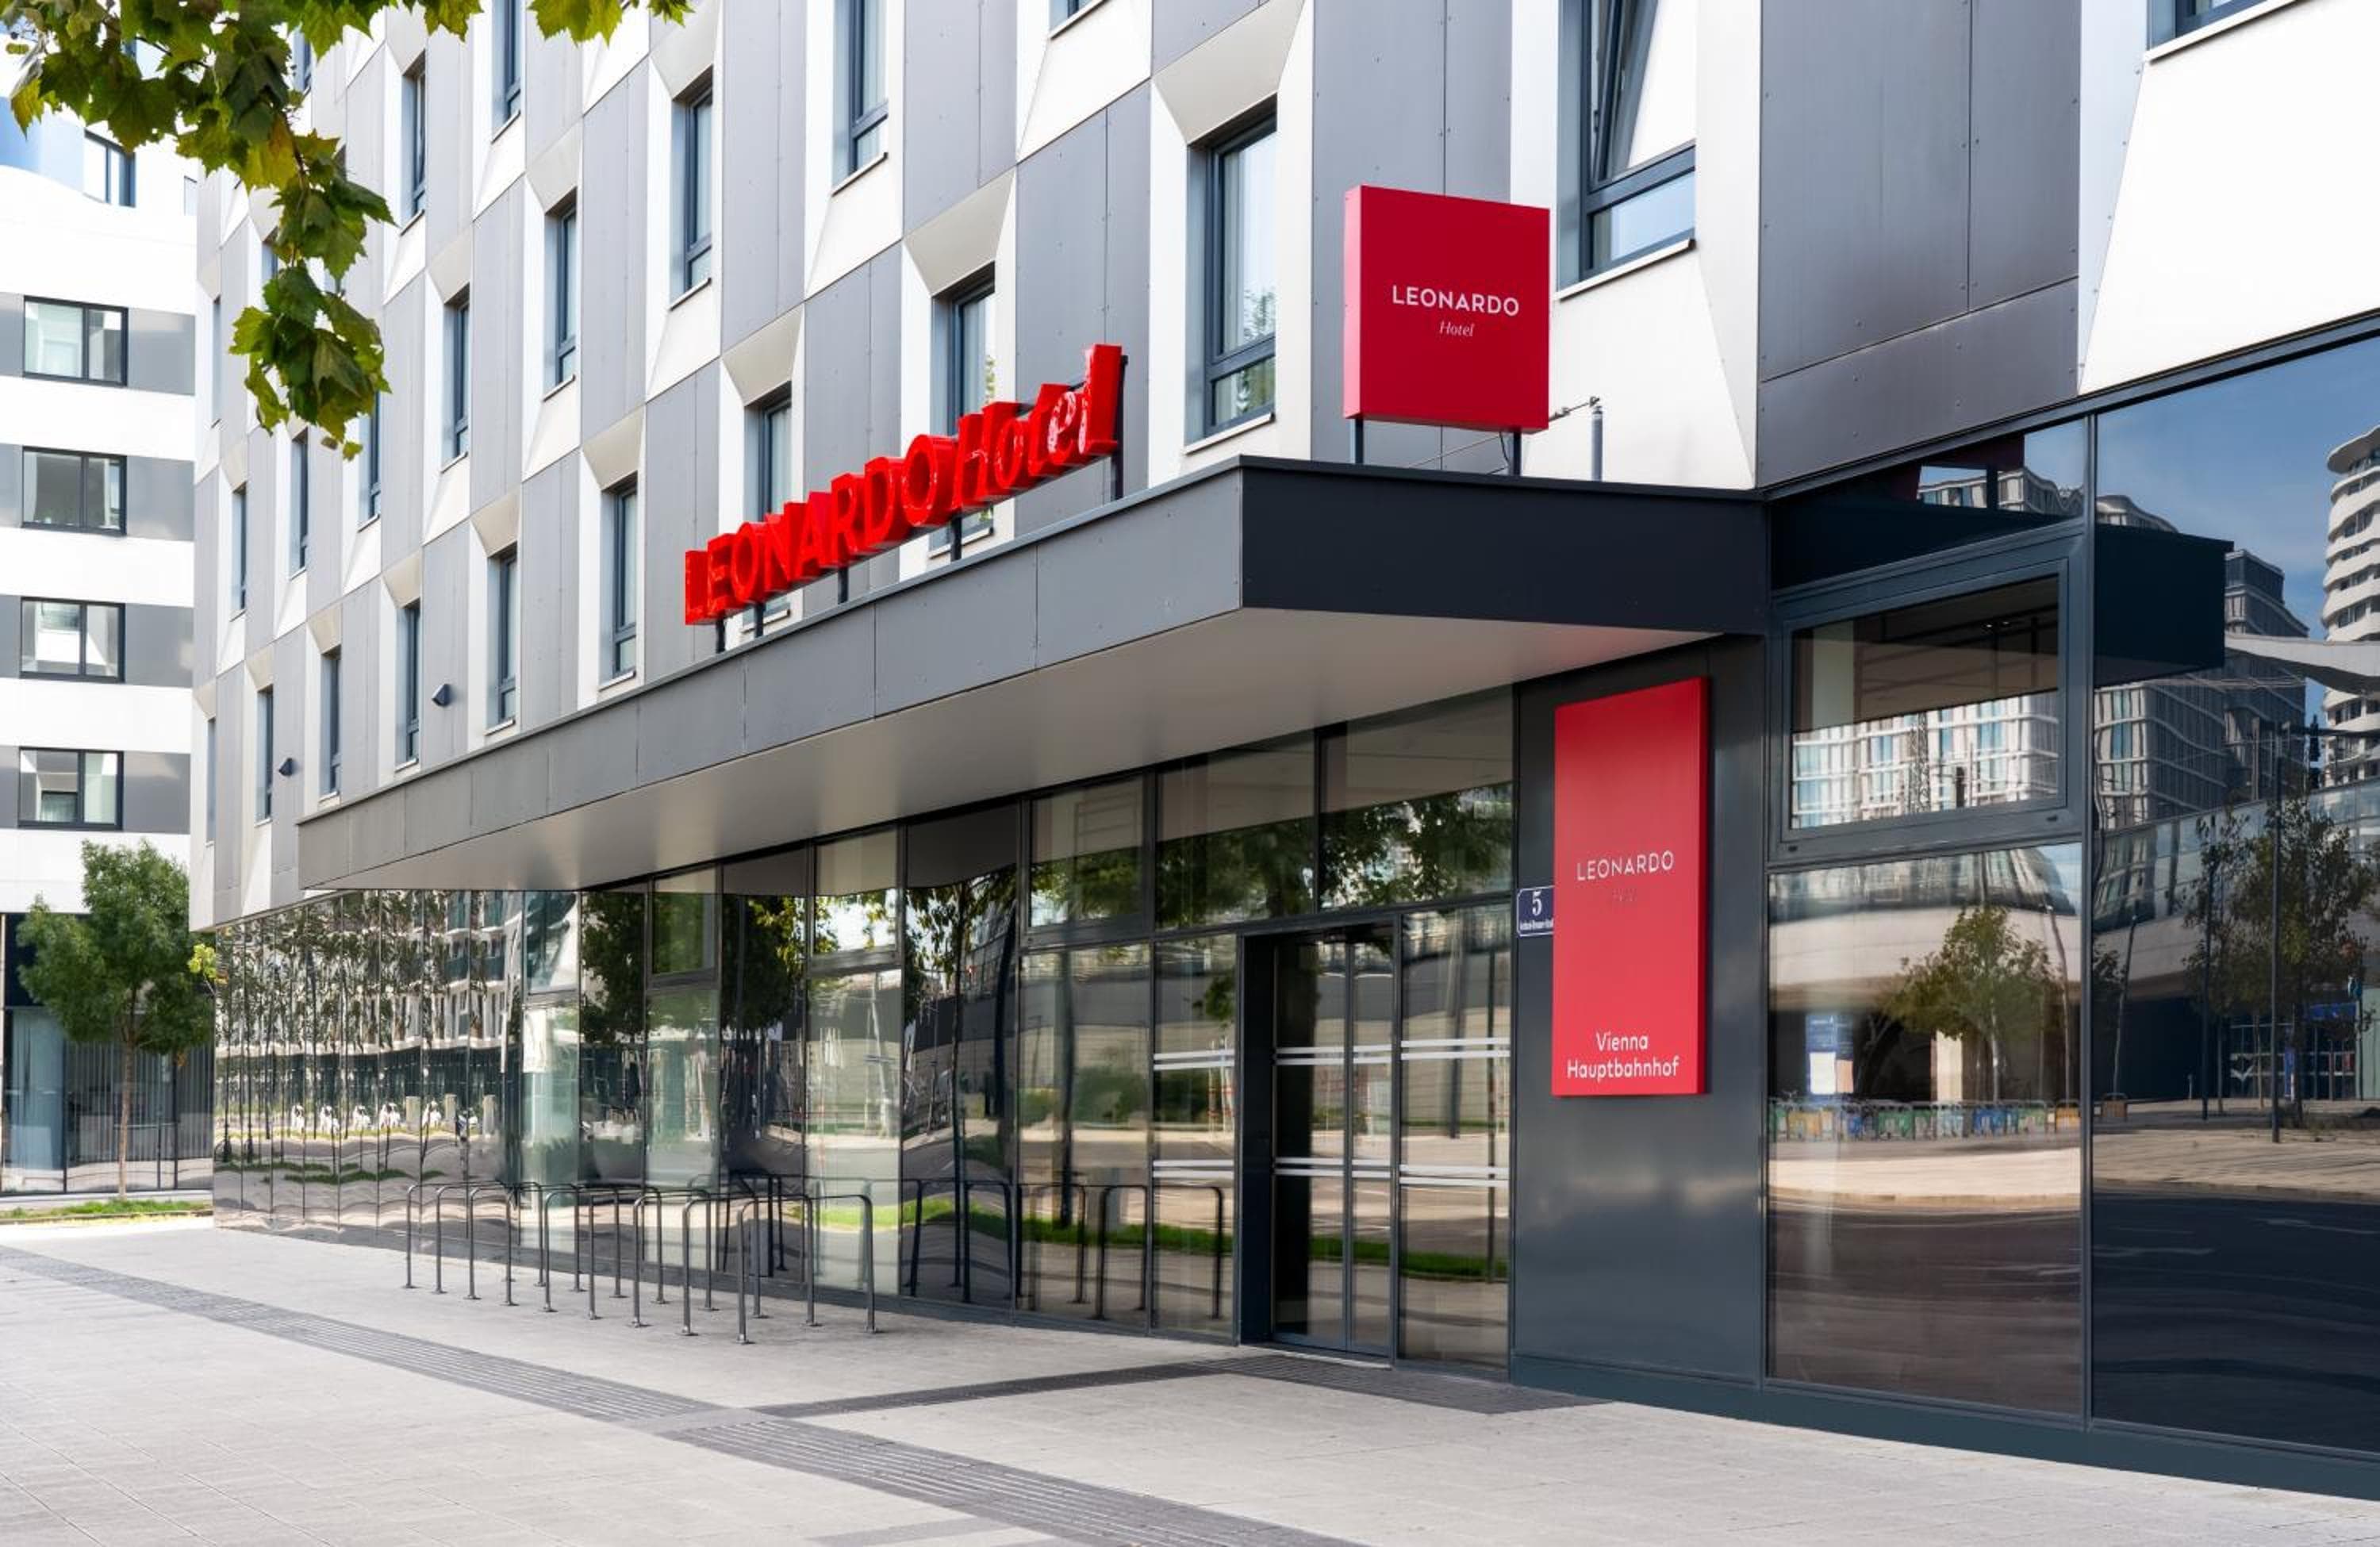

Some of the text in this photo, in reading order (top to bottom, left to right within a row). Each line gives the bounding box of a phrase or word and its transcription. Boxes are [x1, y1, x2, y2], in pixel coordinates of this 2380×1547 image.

[1392, 285, 1519, 316] LEONARDO
[1438, 320, 1476, 338] Hotel
[685, 344, 1123, 625] LEONARDO Hotel
[1576, 850, 1674, 881] LEONARDO
[1532, 890, 1543, 916] 5
[1595, 1031, 1649, 1052] Vienna
[1566, 1055, 1679, 1083] Hauptbahnhof
